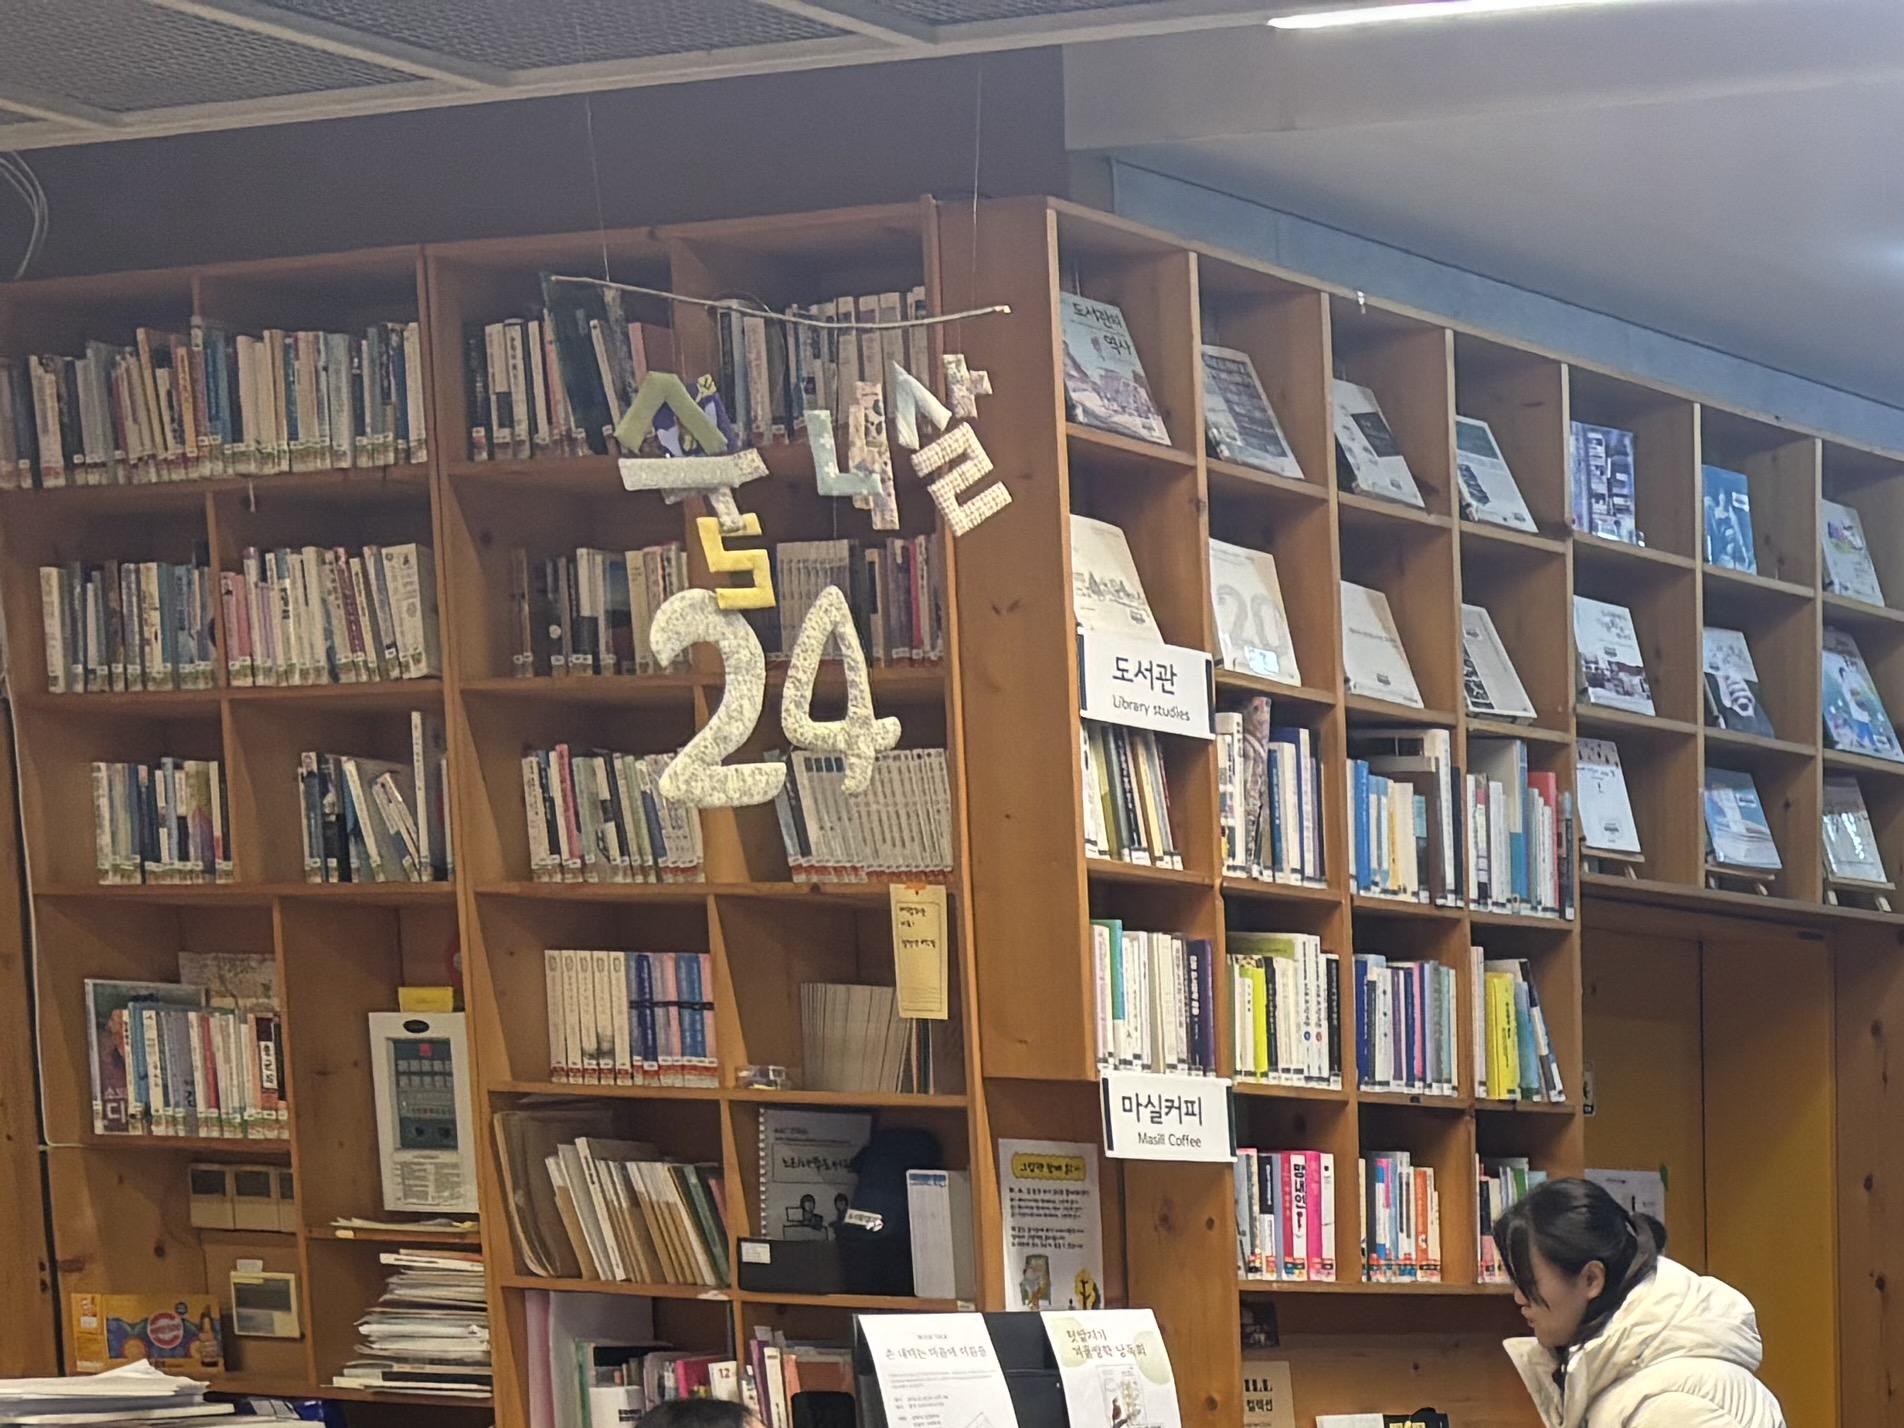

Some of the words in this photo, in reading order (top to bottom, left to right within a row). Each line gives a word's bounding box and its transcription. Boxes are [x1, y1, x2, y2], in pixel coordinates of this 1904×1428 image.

[1112, 656, 1177, 695] 도서관
[649, 584, 902, 808] 24
[1112, 695, 1151, 717] Library
[1153, 704, 1191, 722] studies
[1122, 1092, 1202, 1126] 마실커피
[1168, 1133, 1202, 1148] Coffee
